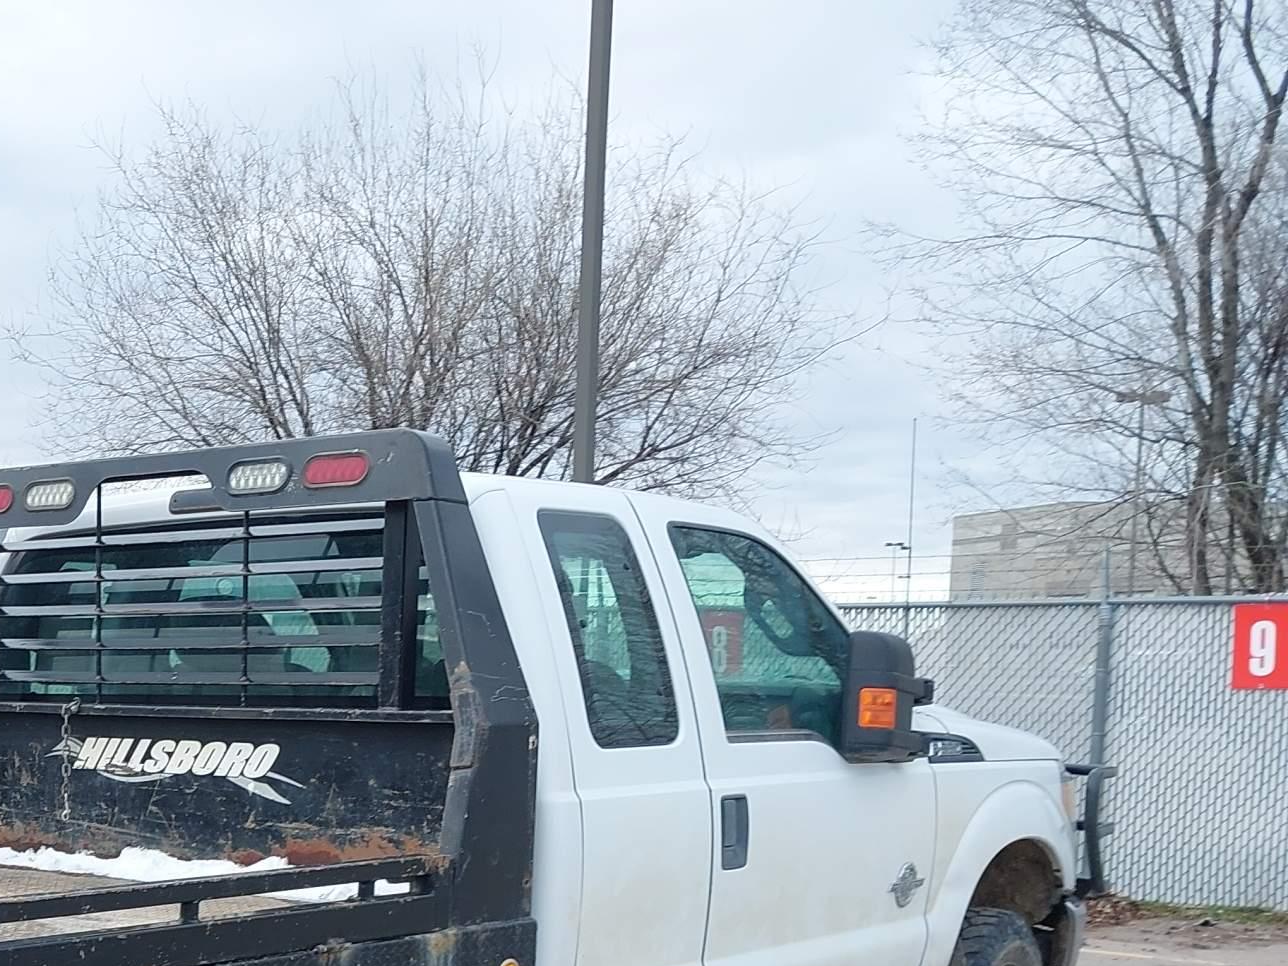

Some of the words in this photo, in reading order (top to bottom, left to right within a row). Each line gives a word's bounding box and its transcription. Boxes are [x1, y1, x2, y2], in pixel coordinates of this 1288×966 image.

[712, 625, 728, 673] 8
[1248, 620, 1277, 677] 9
[72, 737, 280, 778] HILLSBORO
